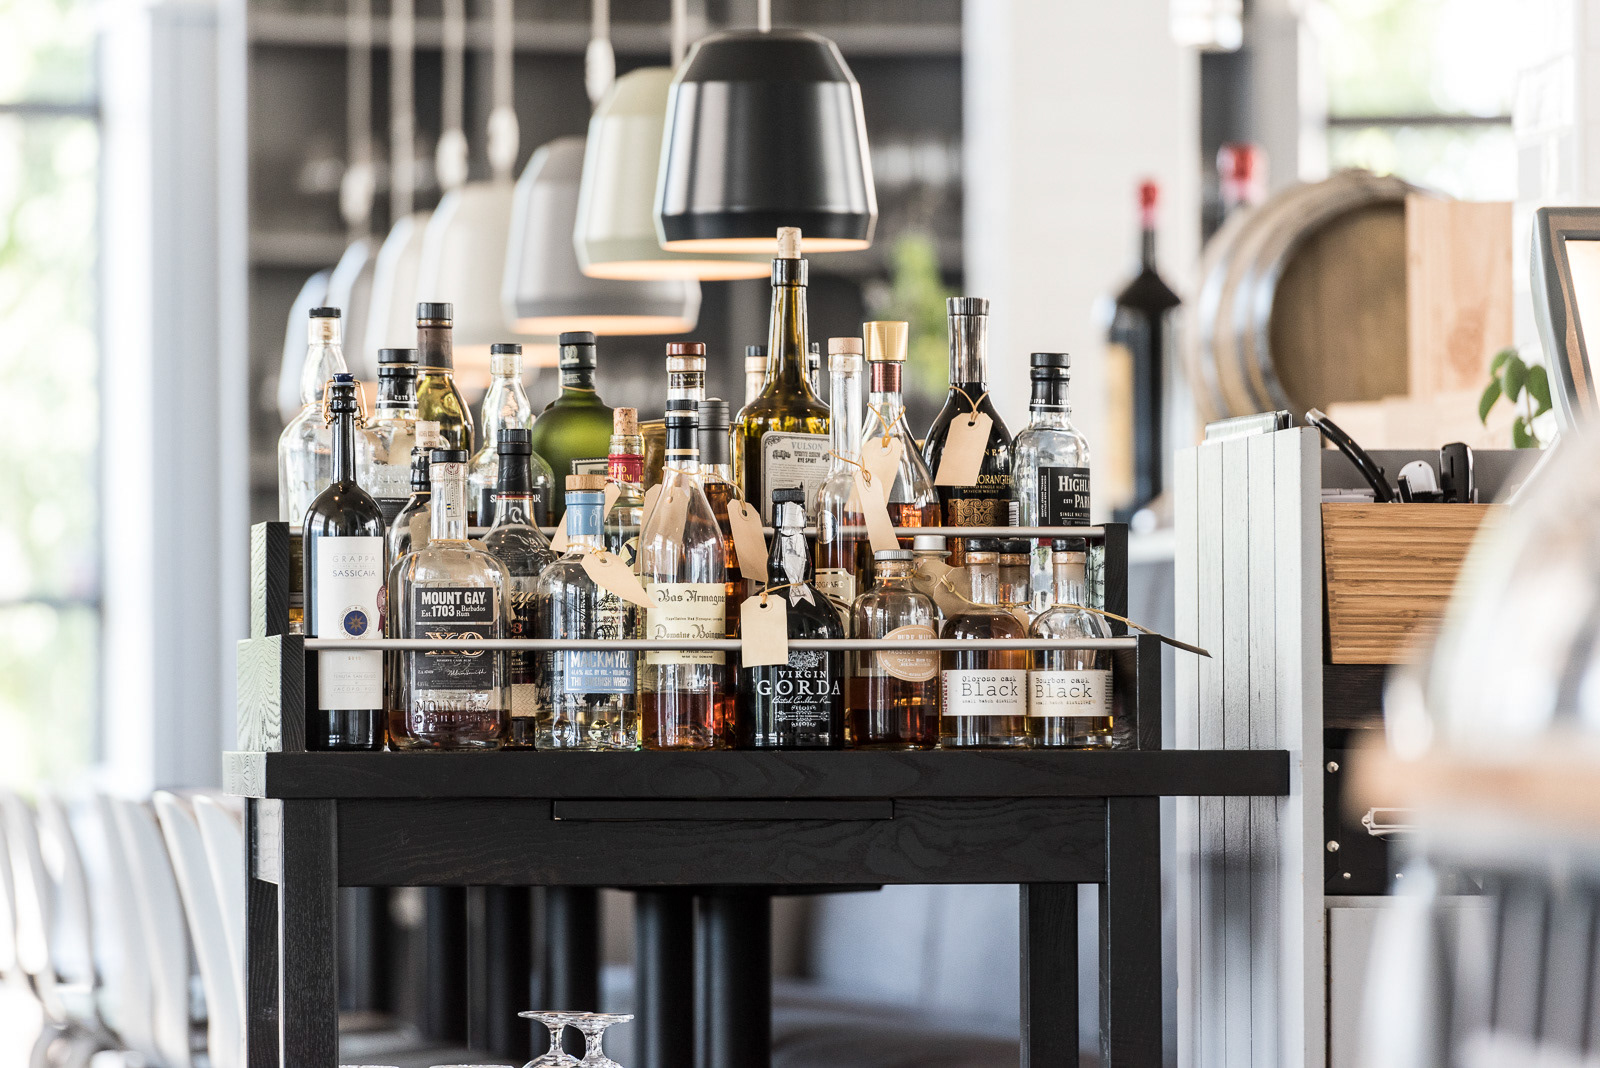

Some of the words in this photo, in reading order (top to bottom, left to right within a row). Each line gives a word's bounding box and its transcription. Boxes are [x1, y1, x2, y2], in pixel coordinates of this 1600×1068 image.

[791, 441, 823, 451] VULSON
[332, 555, 376, 563] GRAPPA
[332, 569, 376, 577] SASSICAIA
[421, 591, 462, 605] MOUNT
[464, 591, 486, 605] GAY
[431, 605, 455, 618] 1703
[456, 609, 470, 617] Rum
[461, 604, 486, 612] Barbados
[421, 609, 433, 618] Est.
[654, 623, 690, 640] Domaine
[570, 650, 631, 669] MACKMYRA
[779, 670, 827, 679] VIRGIN
[962, 675, 997, 683] Oloroso
[756, 679, 841, 696] GORDA
[961, 681, 1018, 697] Black
[1035, 683, 1093, 698] Black
